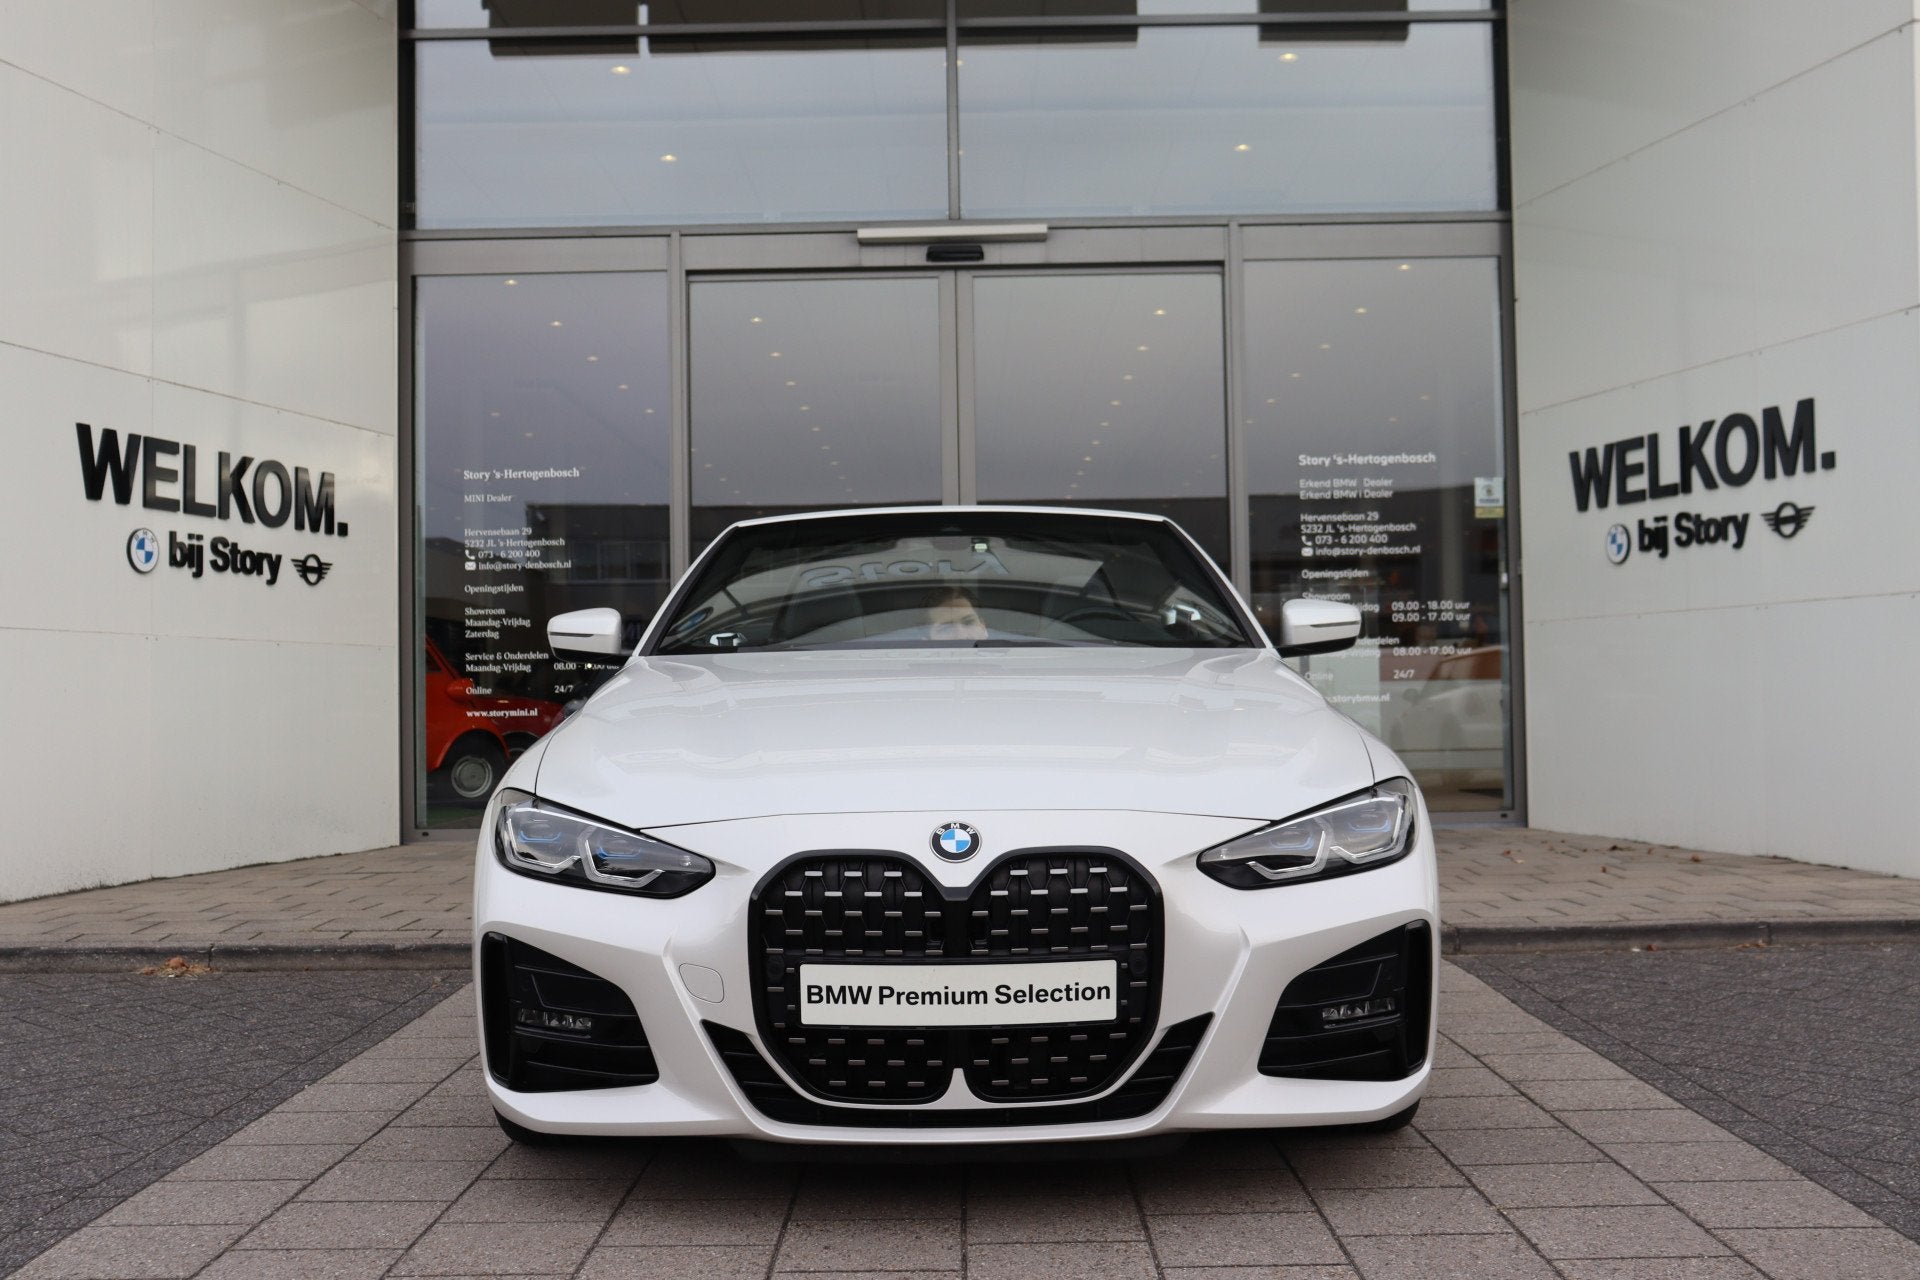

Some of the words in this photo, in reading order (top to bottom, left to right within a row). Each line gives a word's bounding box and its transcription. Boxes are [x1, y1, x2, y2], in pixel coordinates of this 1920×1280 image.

[1298, 454, 1330, 467] Story
[1333, 453, 1436, 466] 's-Hertogenbosch
[1569, 398, 1836, 513] WELKOM.
[76, 422, 348, 537] WELKOM.
[464, 470, 490, 482] Story
[1300, 478, 1331, 488] Erkend
[1333, 478, 1358, 488] BMW
[1363, 478, 1394, 487] Dealer
[464, 494, 484, 503] MINI
[487, 494, 512, 502] Dealer
[1300, 490, 1331, 500] Erkend
[1333, 490, 1358, 499] BMW
[1364, 489, 1394, 498] Dealer
[1300, 513, 1365, 522] Hervensebaan
[1367, 512, 1378, 521] 29
[522, 528, 532, 536] 29
[1300, 524, 1324, 534] 5232
[1326, 524, 1335, 534] JL
[1315, 535, 1332, 545] 073
[1340, 535, 1347, 544] 6
[1349, 534, 1366, 544] 200
[1369, 534, 1388, 544] 400
[1638, 515, 1668, 558] bij
[1674, 512, 1750, 550] Story
[464, 540, 484, 548] 5232
[486, 539, 496, 548] JL
[169, 531, 204, 578] bij
[210, 536, 282, 586] Story
[478, 550, 494, 558] 073
[500, 550, 506, 558] 6
[508, 550, 523, 558] 200
[524, 550, 540, 558] 400
[1302, 569, 1368, 580] Openingstijden
[464, 584, 524, 594] Openingstijden
[1392, 601, 1420, 611] 09.00
[1455, 602, 1470, 610] uur
[465, 608, 505, 616] Showroom
[1392, 612, 1420, 622] 09.00
[1456, 612, 1471, 620] uur
[465, 618, 531, 628] Maandag-Vrijdag
[465, 630, 500, 639] Zaterdag
[466, 652, 494, 660] Service
[504, 652, 549, 660] Onderdelen
[1393, 646, 1420, 656] 08.00
[466, 663, 531, 672] Maandag-Vrijdag
[554, 662, 576, 670] 08.00
[1304, 672, 1334, 681] Online
[1394, 670, 1414, 680] 24/7
[466, 687, 492, 695] Online
[554, 685, 574, 694] 24/7
[466, 708, 538, 718] www.storymini.nl
[936, 822, 976, 834] BMW
[806, 984, 872, 1004] BMW
[878, 986, 988, 1006] Premium
[994, 982, 1110, 1004] Selection
